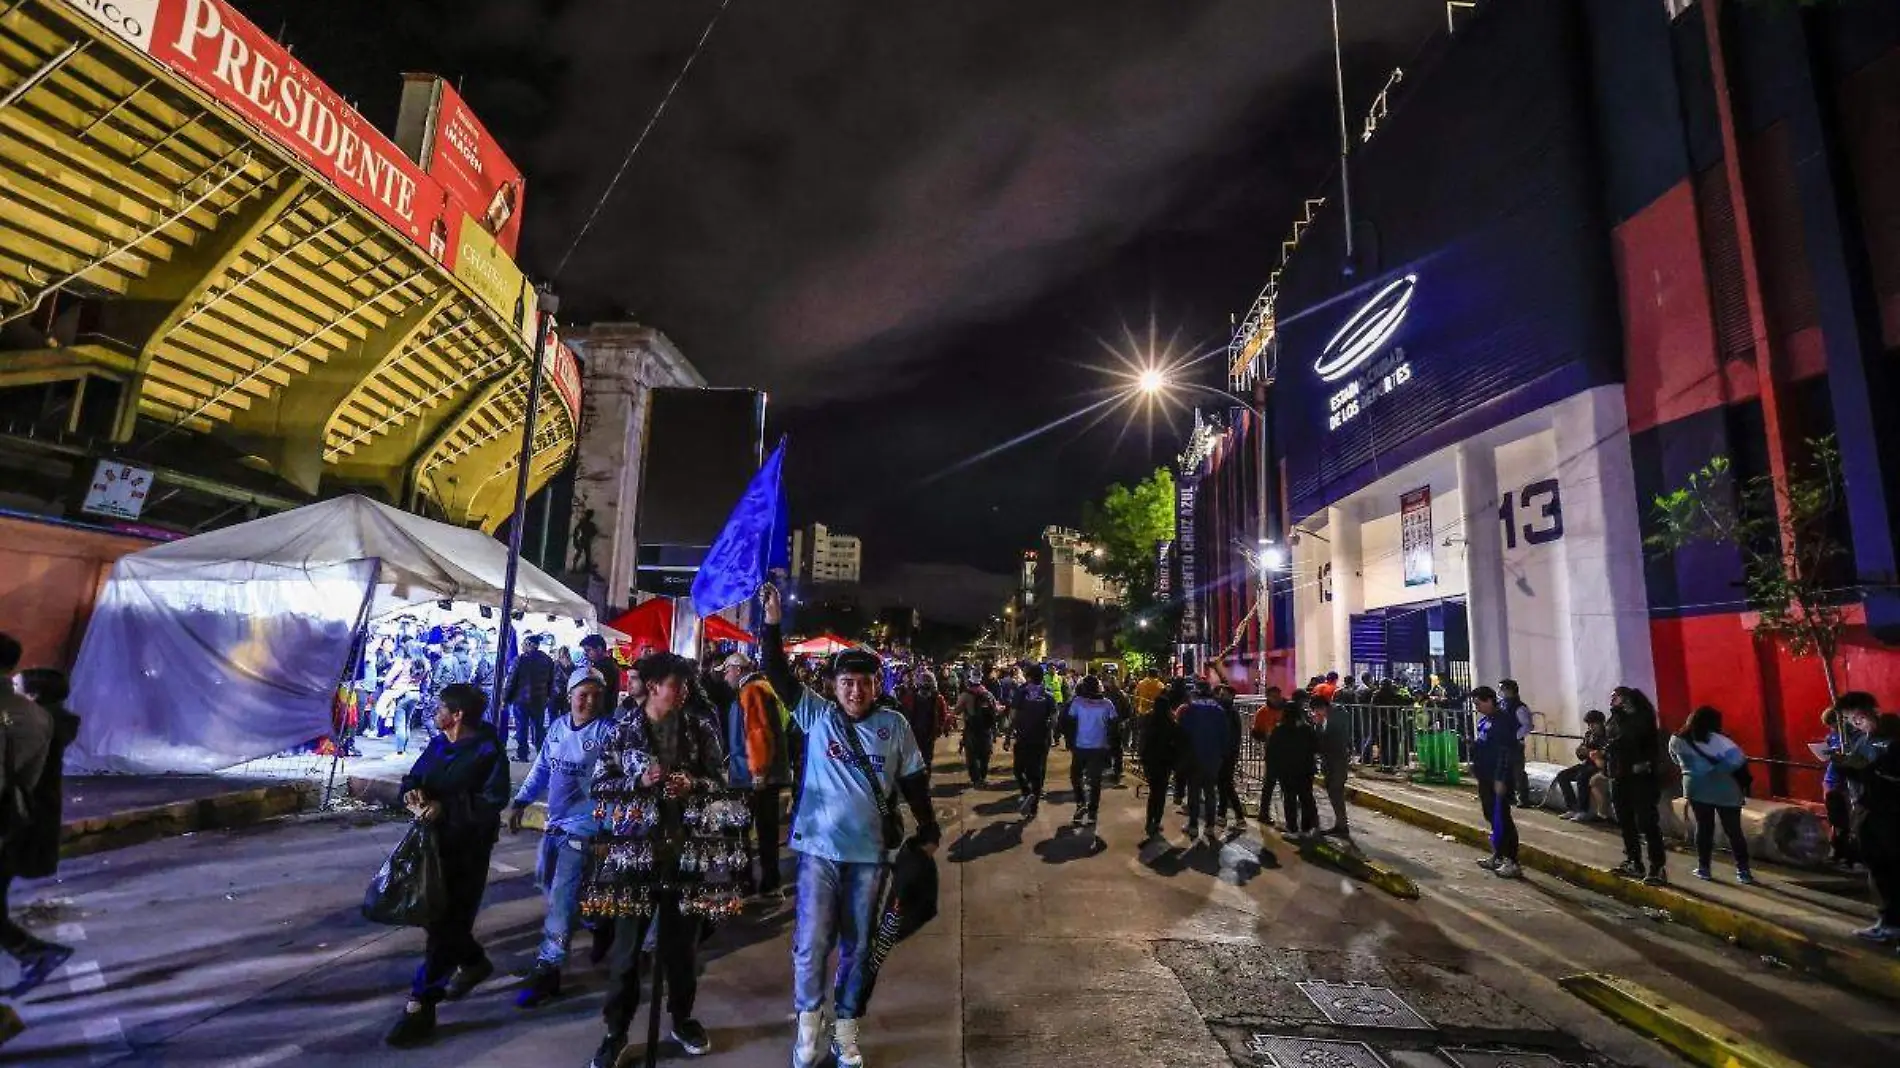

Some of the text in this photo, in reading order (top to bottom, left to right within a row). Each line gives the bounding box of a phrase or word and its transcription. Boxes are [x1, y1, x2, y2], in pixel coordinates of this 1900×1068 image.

[171, 0, 416, 222] PRESIDENTE
[444, 124, 482, 174] IMAGEN
[1342, 399, 1359, 421] LOS
[1180, 486, 1193, 516] AZUL
[1499, 478, 1563, 548] 13
[1180, 519, 1194, 551] CRUZ
